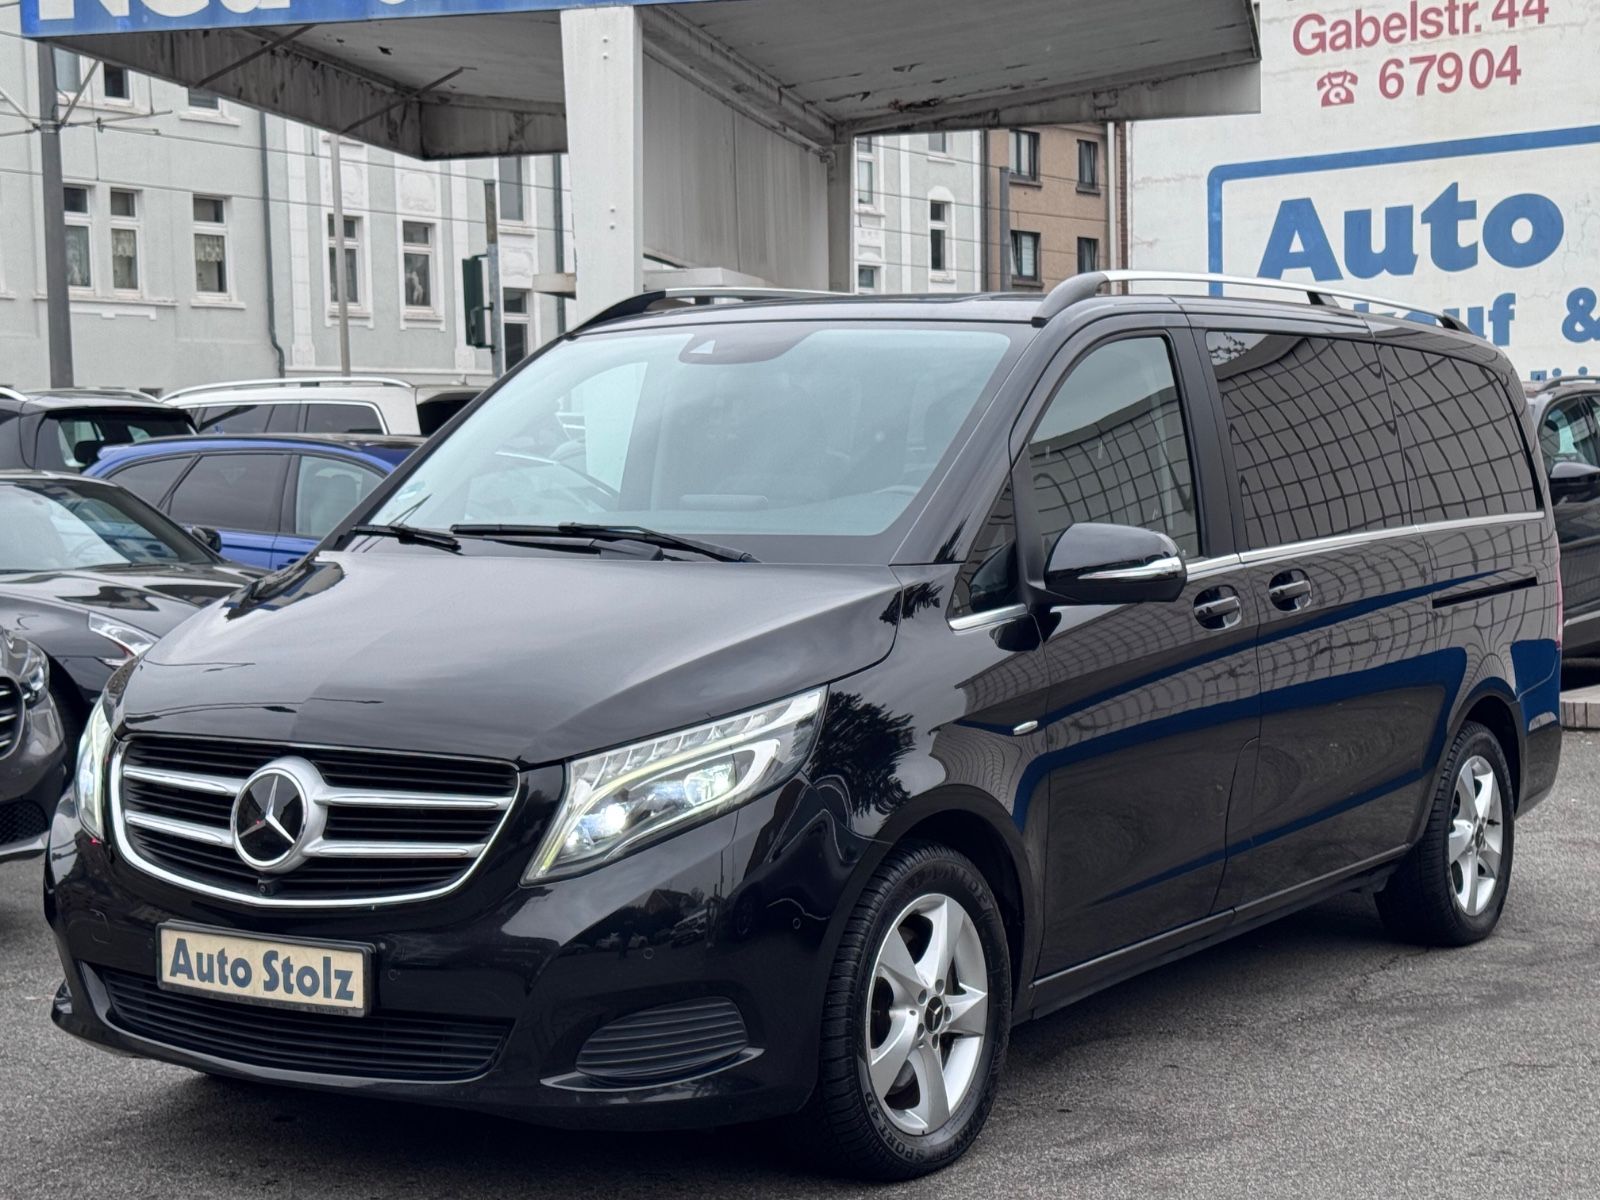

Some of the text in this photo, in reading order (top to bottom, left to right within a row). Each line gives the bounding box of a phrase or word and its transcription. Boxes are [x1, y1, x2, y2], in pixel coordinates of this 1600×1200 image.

[1293, 0, 1482, 56] Gabelstr.
[1379, 45, 1521, 99] 67904
[1257, 182, 1564, 282] Auto
[169, 938, 354, 1001] Auto Stolz
